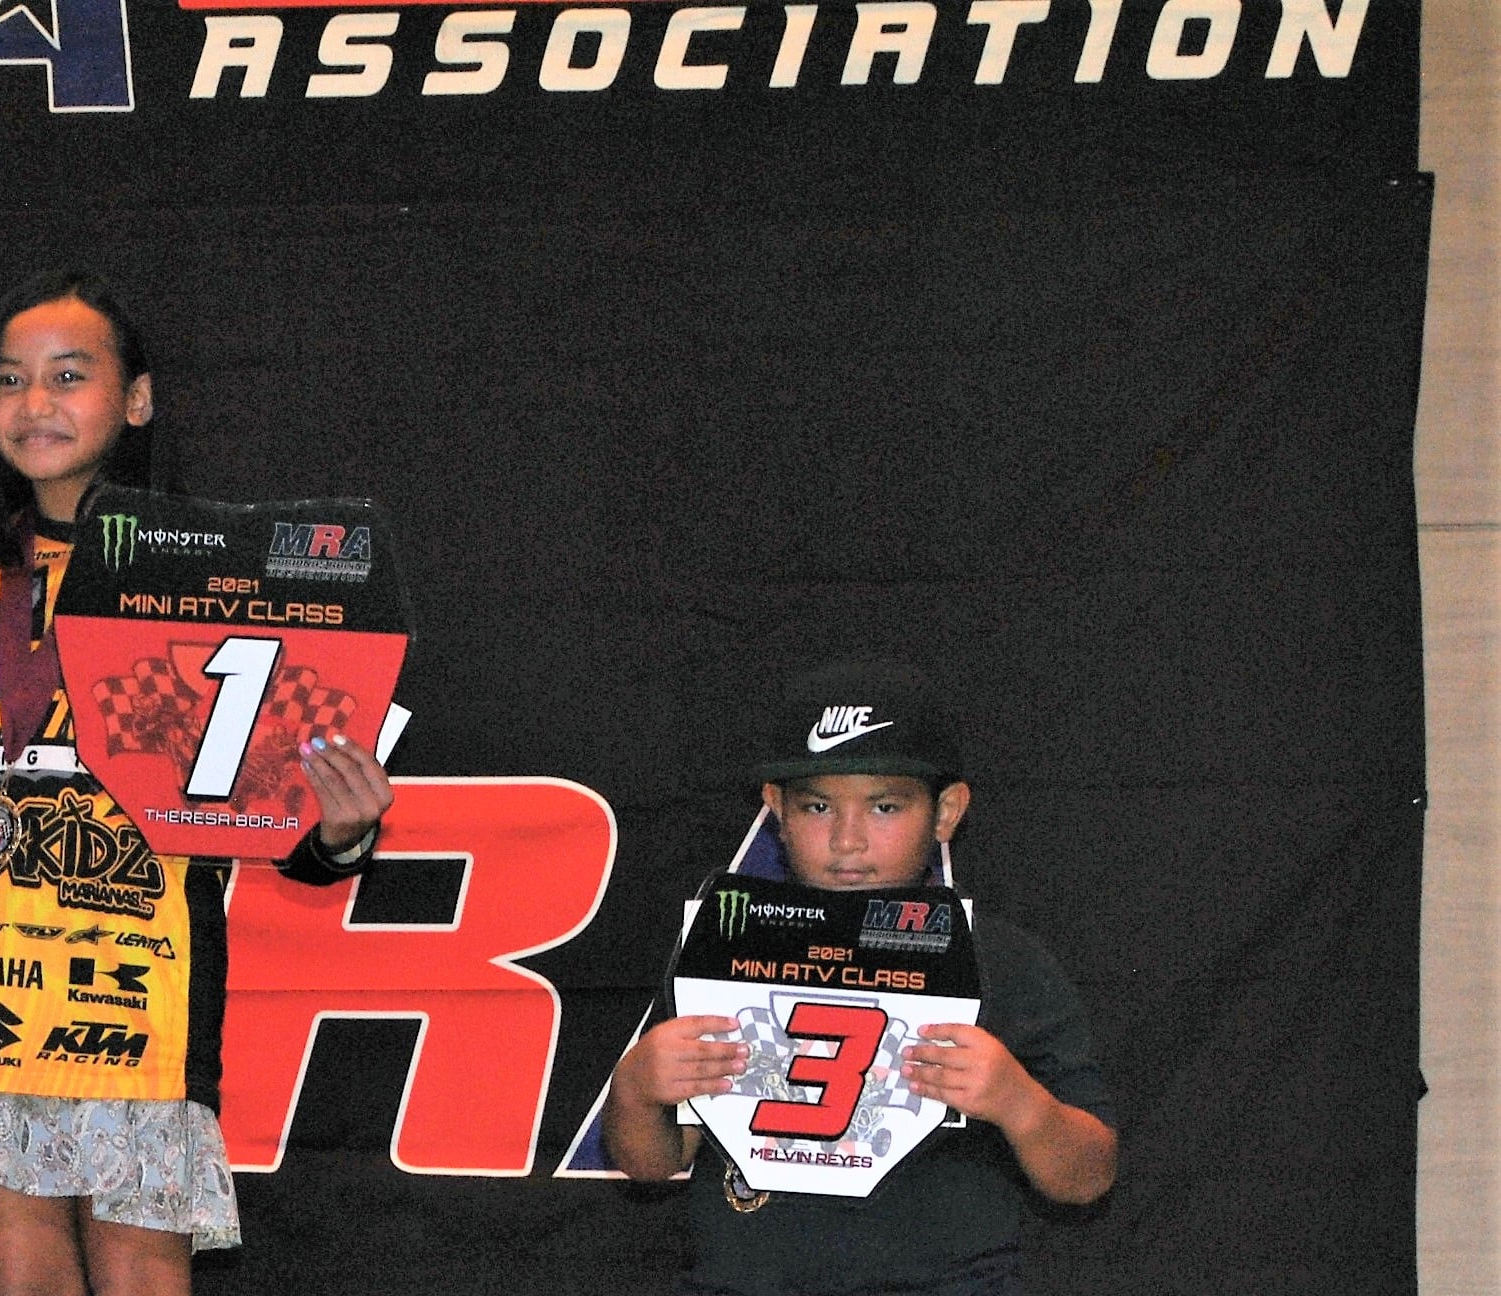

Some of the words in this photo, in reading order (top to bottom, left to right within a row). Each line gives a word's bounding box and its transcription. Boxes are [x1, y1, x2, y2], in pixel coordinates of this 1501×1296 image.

[189, 0, 1366, 98] ASSOCIATION
[269, 522, 371, 559] MRA
[208, 577, 259, 594] 2021
[119, 593, 172, 615] MINI
[179, 596, 239, 619] ATV
[248, 600, 344, 624] CLASS
[186, 635, 283, 802] 1
[818, 706, 873, 733] NIKE
[144, 808, 230, 826] THERESA
[236, 814, 299, 830] BORJA
[862, 899, 952, 932] MRA
[807, 946, 853, 961] 2021
[731, 959, 777, 979] MINI
[782, 962, 835, 982] ATV
[841, 967, 925, 989] CLASS
[67, 988, 148, 1011] Kawasaki
[42, 1020, 149, 1058] KTM
[35, 1052, 141, 1068] RACING
[749, 1002, 888, 1141] 3
[750, 1147, 812, 1164] MELVIN
[815, 1153, 873, 1169] REYES
